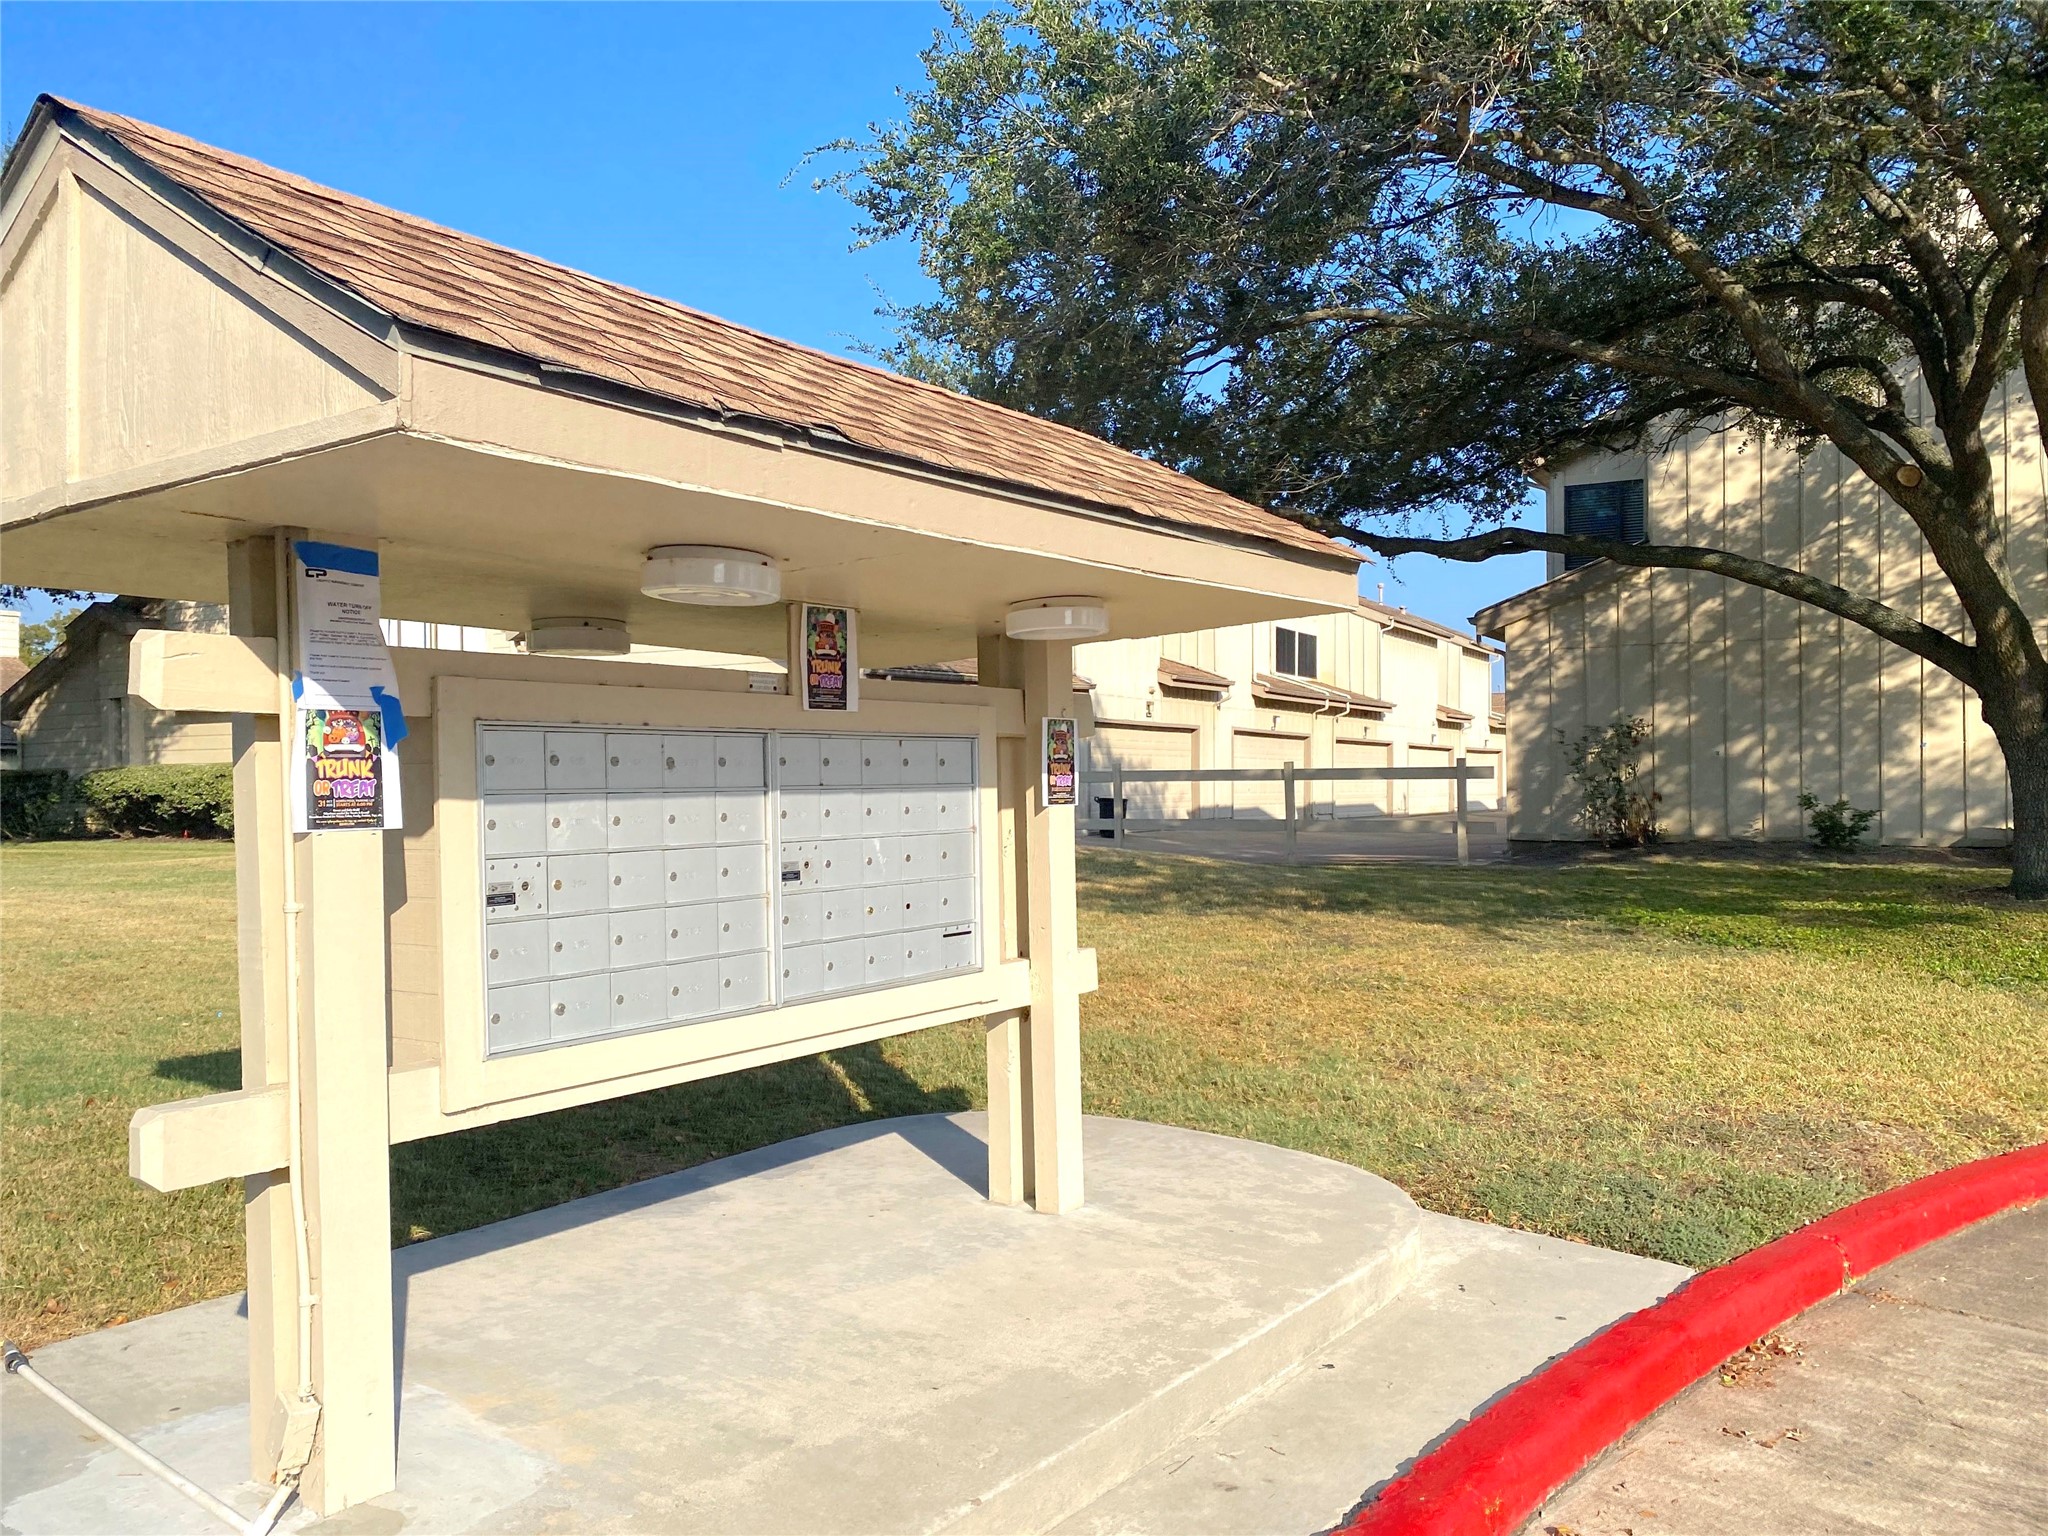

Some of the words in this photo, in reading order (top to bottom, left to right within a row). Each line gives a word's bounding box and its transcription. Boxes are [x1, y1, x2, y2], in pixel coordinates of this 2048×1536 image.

[811, 659, 842, 674] TRUNK
[818, 674, 843, 688] TREAT
[316, 758, 374, 778] TRUNK
[313, 780, 330, 796] OR
[331, 779, 376, 798] TREAT
